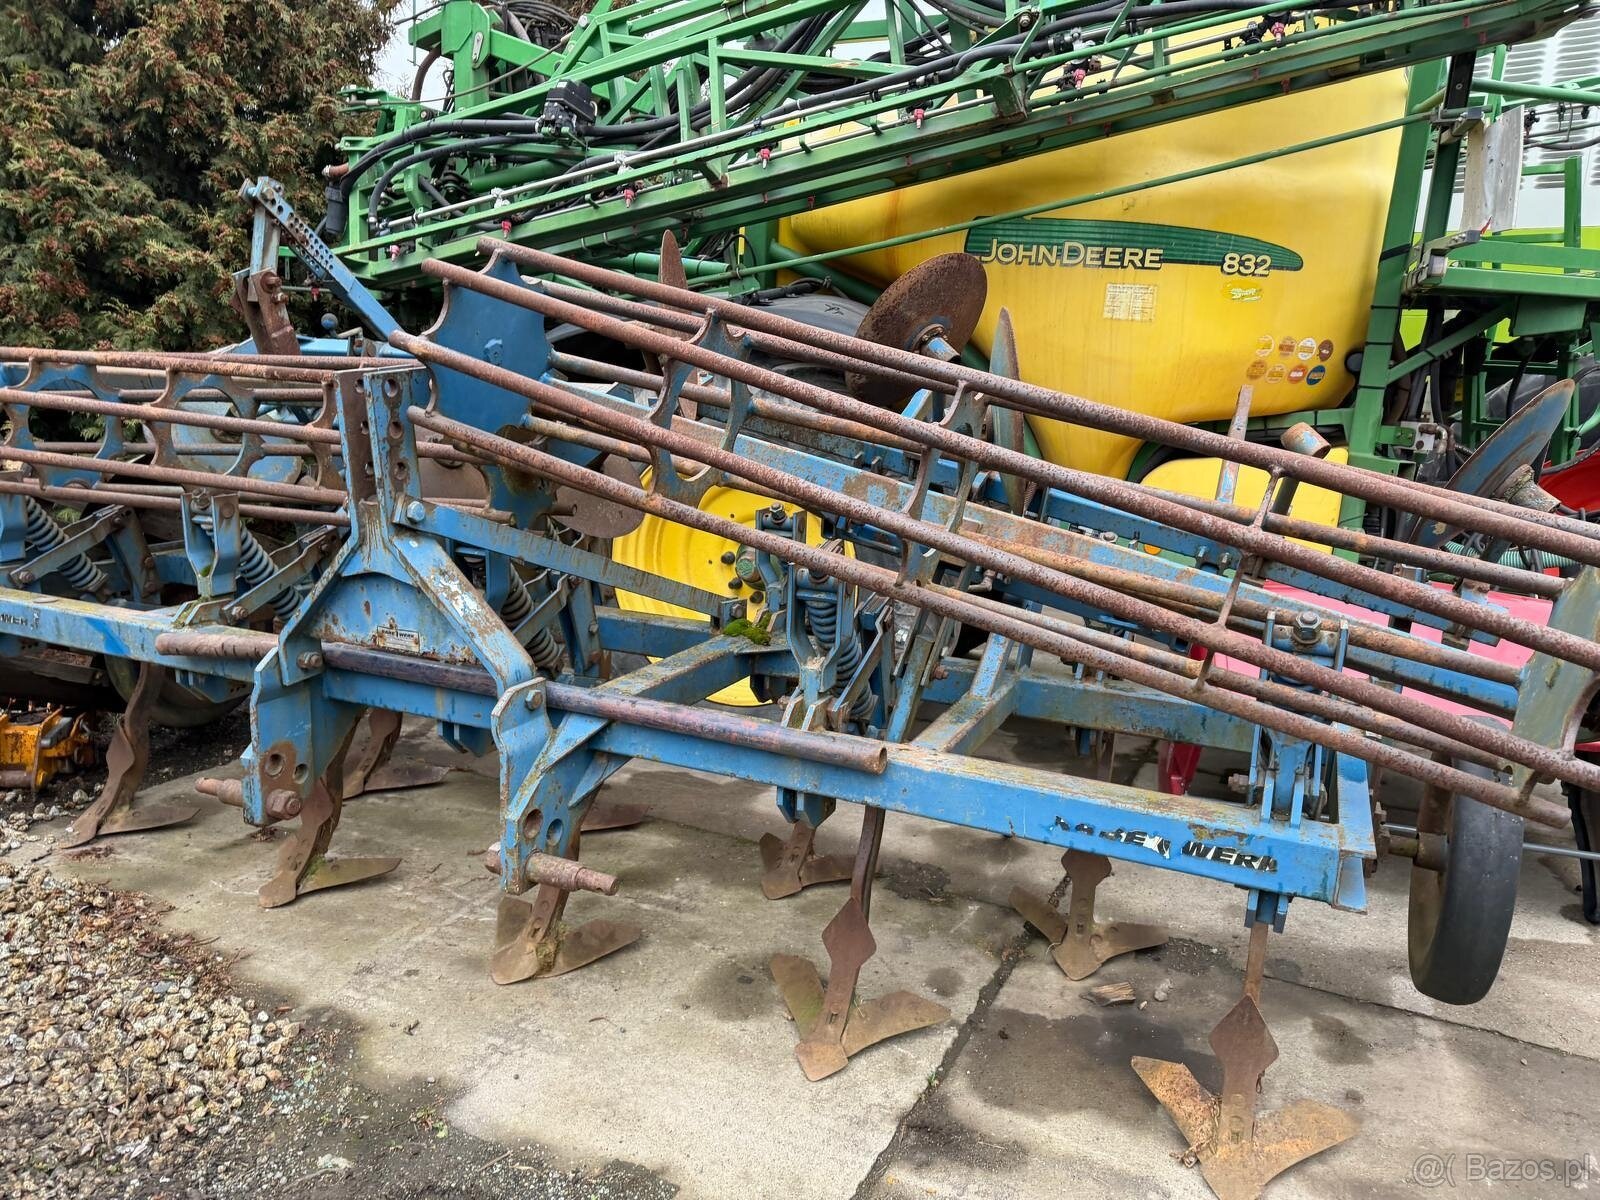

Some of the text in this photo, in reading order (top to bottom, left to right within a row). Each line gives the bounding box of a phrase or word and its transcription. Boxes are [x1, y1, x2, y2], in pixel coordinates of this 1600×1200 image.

[980, 238, 1272, 276] JOHN DEERE 832
